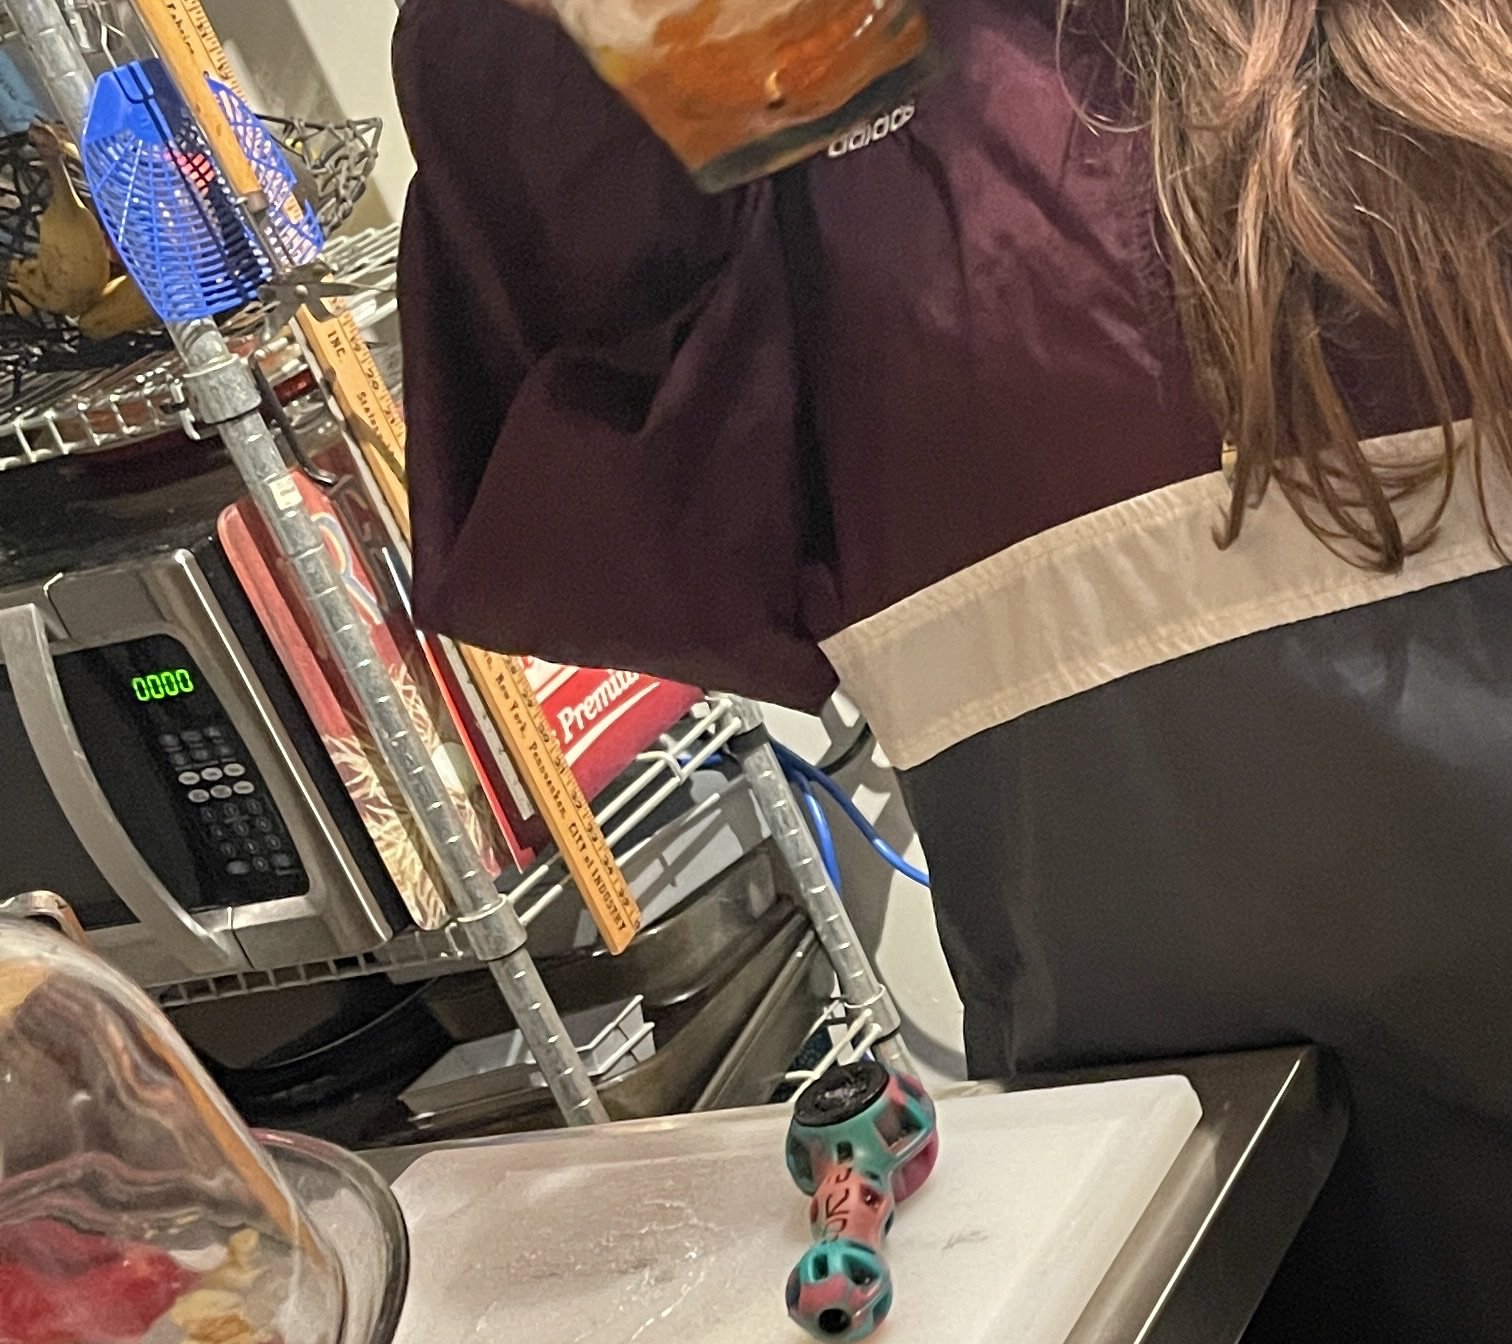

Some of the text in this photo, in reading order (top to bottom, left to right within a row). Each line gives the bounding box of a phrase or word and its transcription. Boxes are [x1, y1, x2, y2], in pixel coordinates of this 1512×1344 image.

[325, 329, 350, 364] INC.
[493, 672, 513, 700] New
[566, 822, 587, 852] CITY
[589, 868, 626, 933] INDUSTRY
